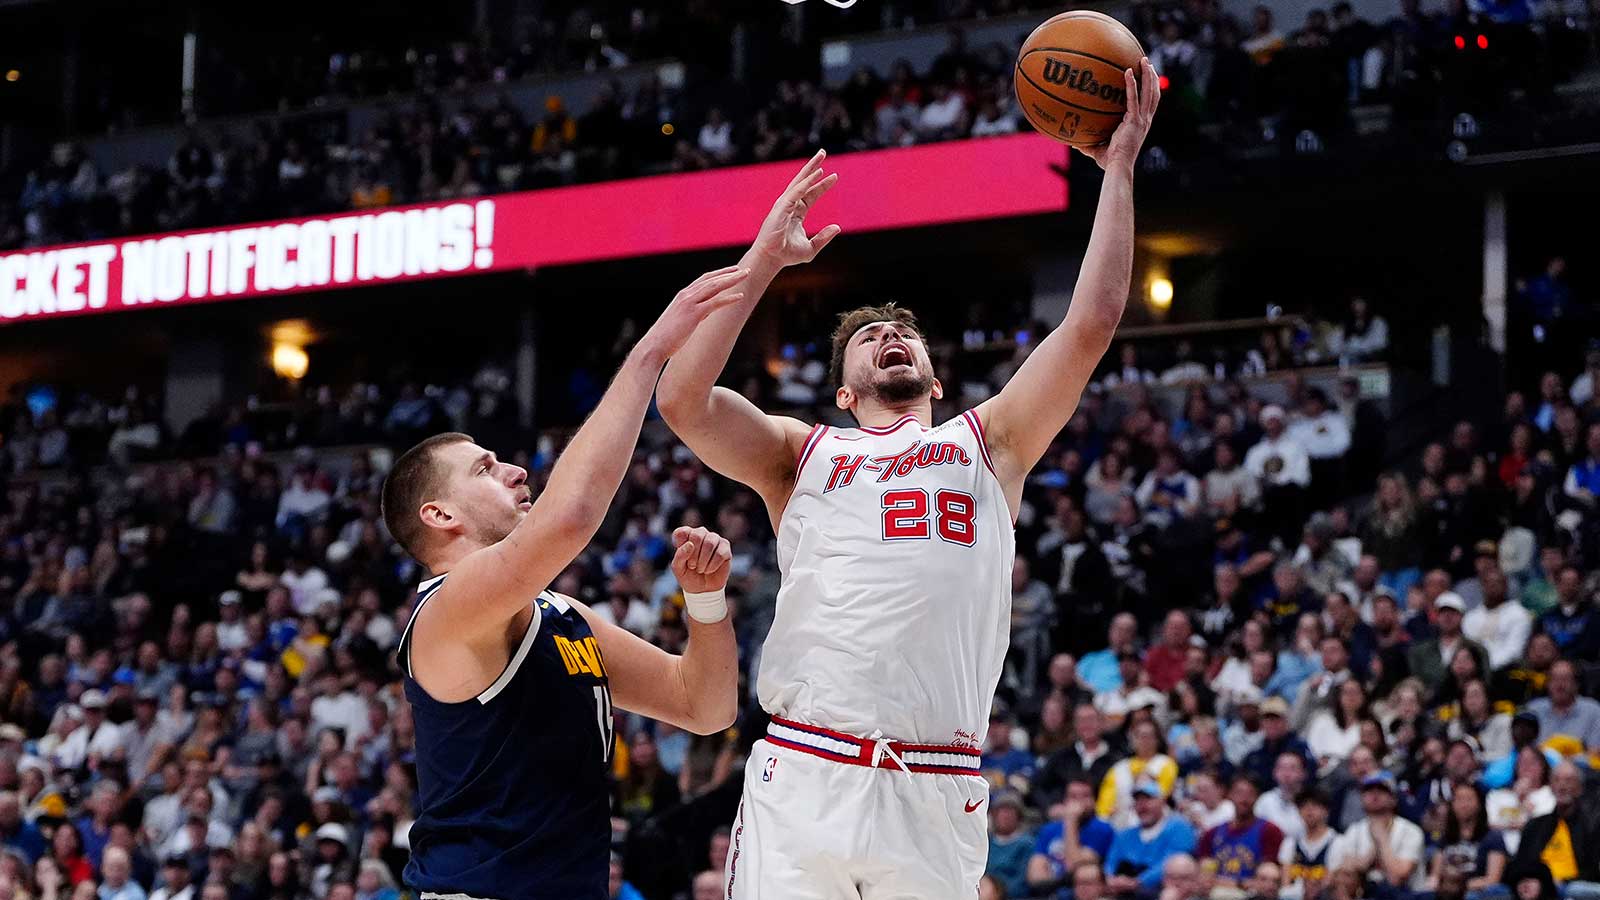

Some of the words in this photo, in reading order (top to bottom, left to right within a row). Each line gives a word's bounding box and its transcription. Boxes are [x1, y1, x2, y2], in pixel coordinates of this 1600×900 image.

[1042, 57, 1126, 106] Wilson
[0, 245, 116, 318] CKET
[121, 199, 495, 305] NOTIFICATIONS!
[823, 440, 972, 494] H-Town
[881, 488, 977, 547] 28
